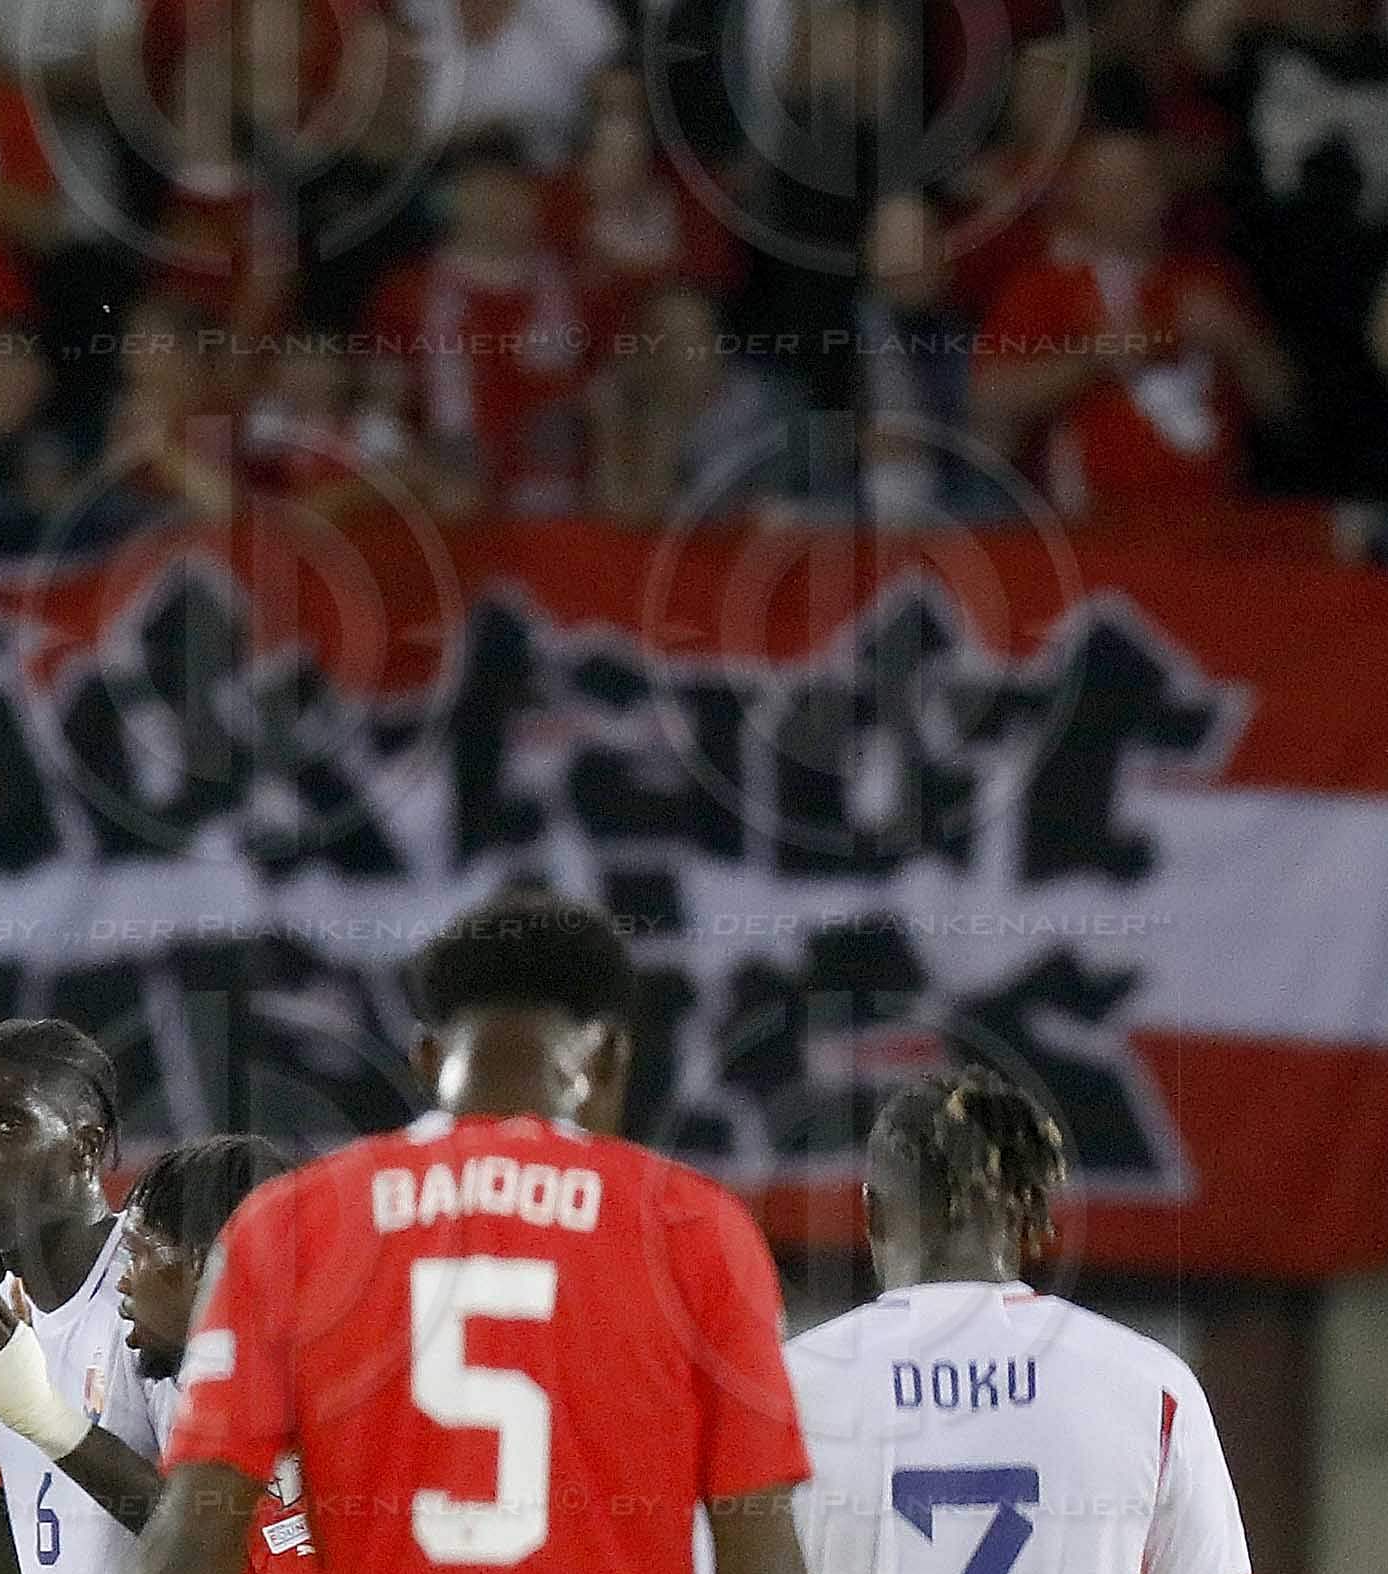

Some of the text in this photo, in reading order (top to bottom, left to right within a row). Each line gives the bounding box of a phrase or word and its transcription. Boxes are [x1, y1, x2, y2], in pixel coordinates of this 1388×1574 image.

[410, 1256, 559, 1565] 5
[893, 1359, 1038, 1410] DOKU
[35, 1472, 61, 1565] 6
